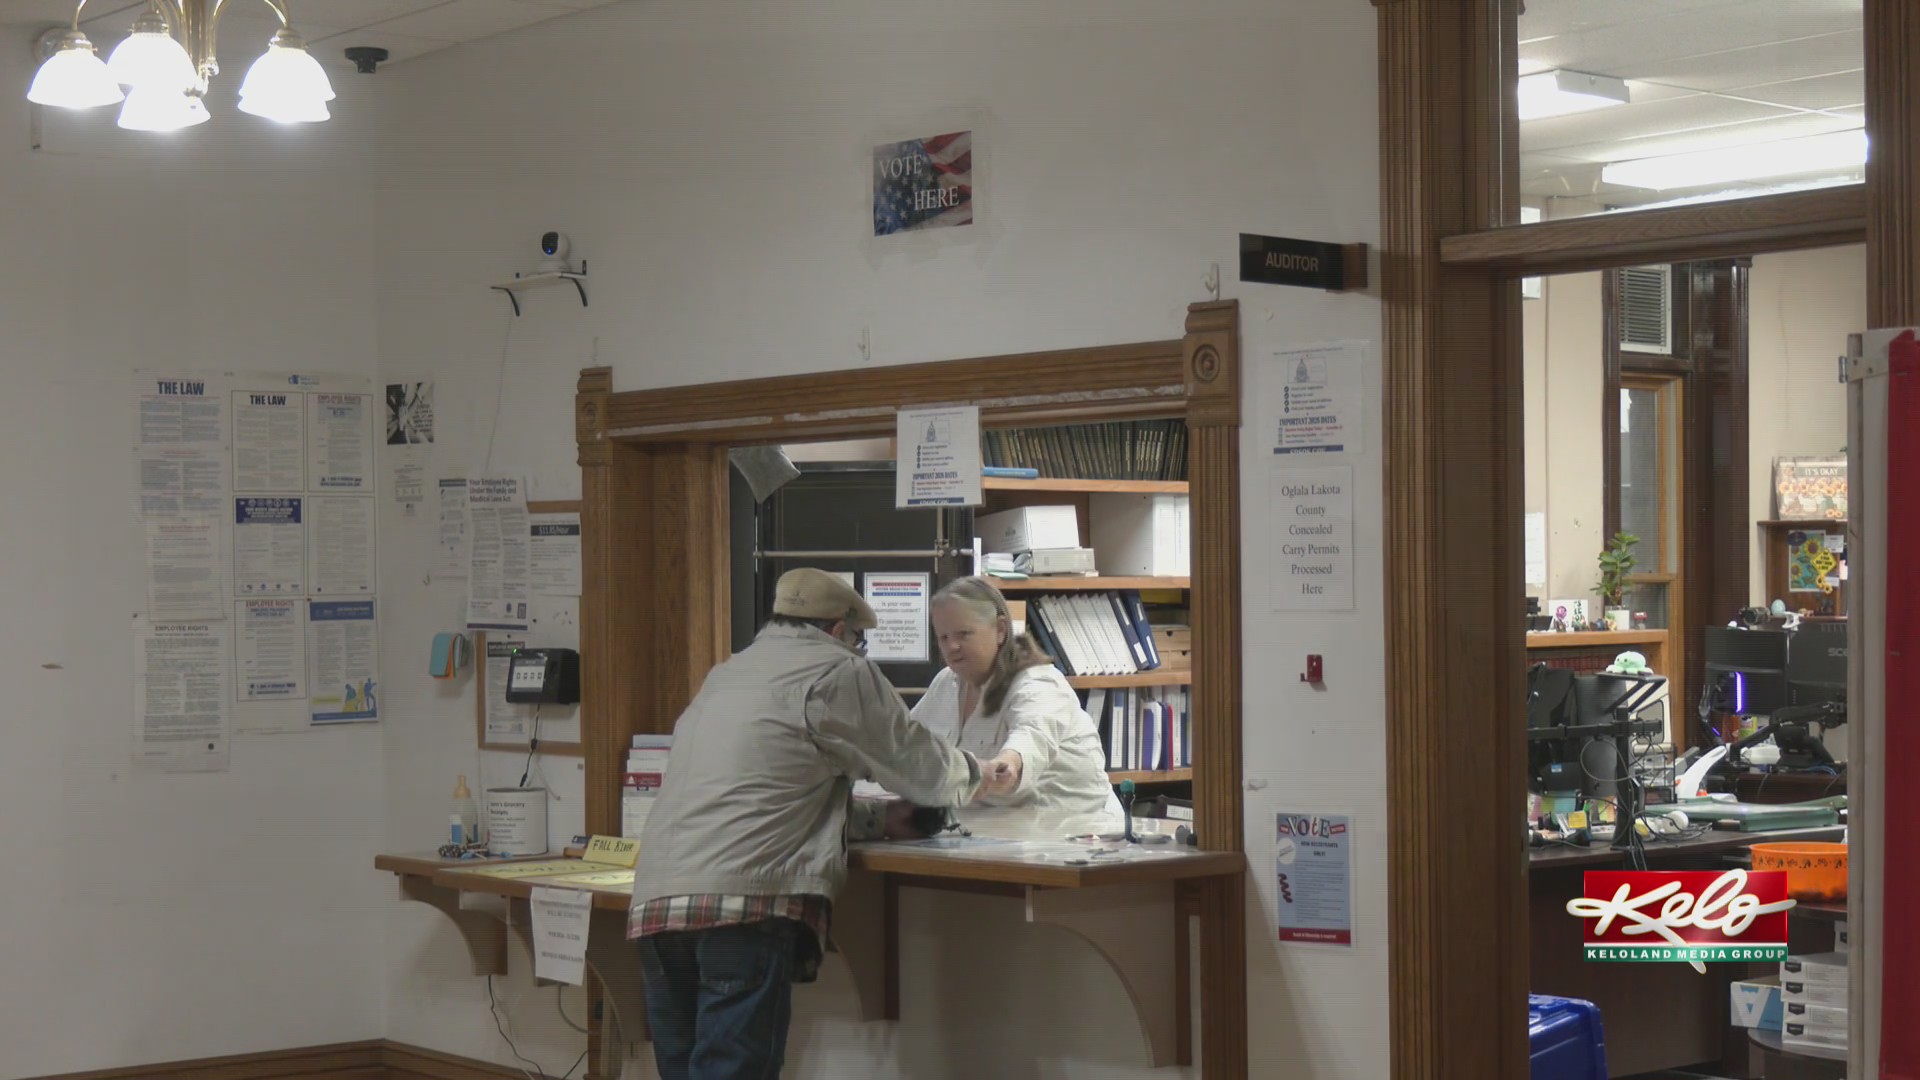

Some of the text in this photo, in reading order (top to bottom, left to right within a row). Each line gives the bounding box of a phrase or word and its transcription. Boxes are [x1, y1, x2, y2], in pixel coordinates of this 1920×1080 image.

[880, 154, 922, 179] VOTE
[914, 186, 960, 211] HERE
[1265, 251, 1319, 272] AUDITOR
[157, 381, 204, 395] THE LAW
[249, 394, 286, 406] THE LAW
[1804, 467, 1839, 476] IT'S OKAY
[1281, 484, 1341, 498] Oglala Lakota
[1295, 504, 1326, 517] County
[1288, 524, 1333, 536] Concealed
[1282, 544, 1340, 557] Carry Permits
[1291, 563, 1333, 575] Processed
[1302, 583, 1323, 595] Here
